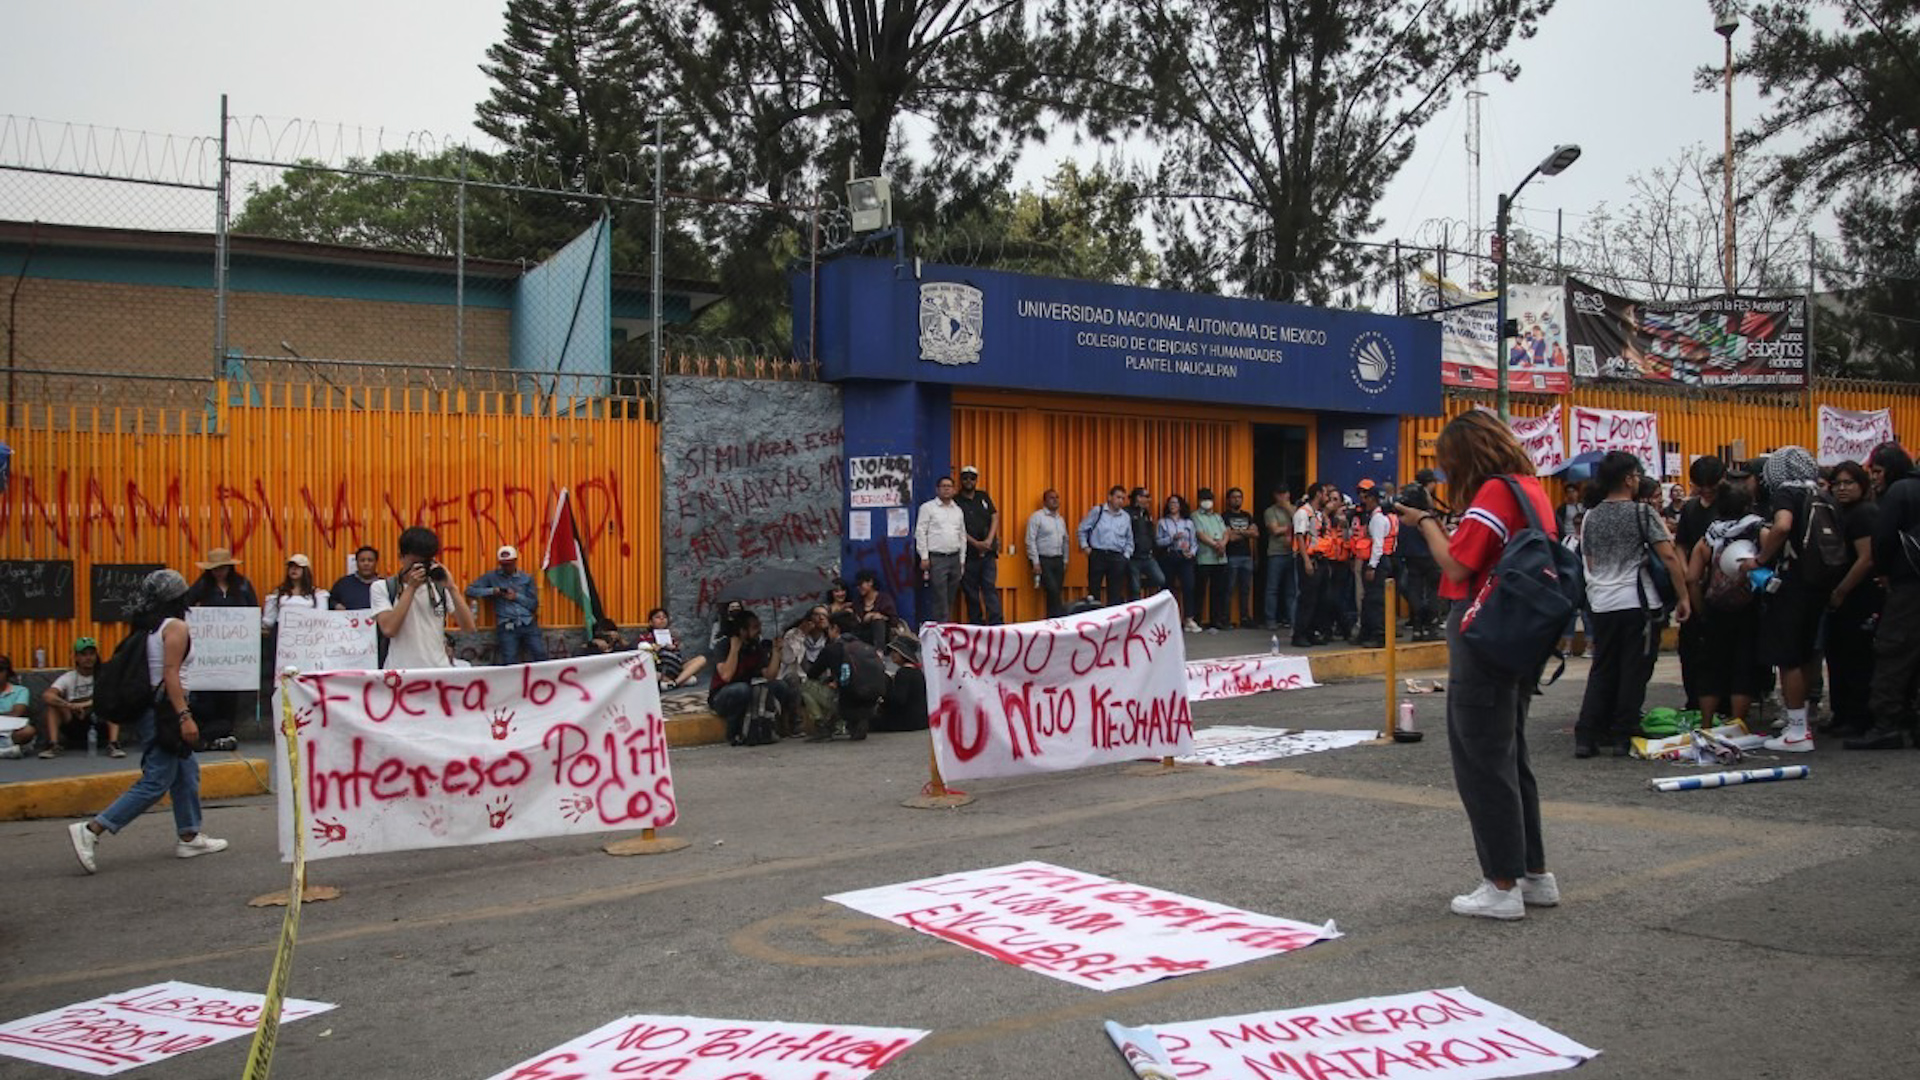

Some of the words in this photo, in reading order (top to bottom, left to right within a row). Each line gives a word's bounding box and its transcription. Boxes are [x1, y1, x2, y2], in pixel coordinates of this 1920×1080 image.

[1017, 300, 1114, 325] UNIVERSIDAD
[1117, 309, 1184, 332] NACIONAL
[1187, 317, 1259, 339] AUTONOMA
[1260, 325, 1278, 341] DE
[1280, 327, 1328, 346] MEXICO
[1077, 331, 1129, 350] COLEGIO
[1131, 336, 1147, 351] DE
[1148, 338, 1198, 356] CIENCIAS
[1200, 344, 1209, 356] Y
[1210, 345, 1283, 363] HUMANIDADES
[1125, 355, 1175, 373] PLANTEL
[1175, 360, 1237, 378] NAUCALPAN
[941, 626, 1055, 679] PUDO
[1071, 605, 1152, 676] SER
[589, 1024, 690, 1050] NO
[1209, 990, 1484, 1049] MURIERON
